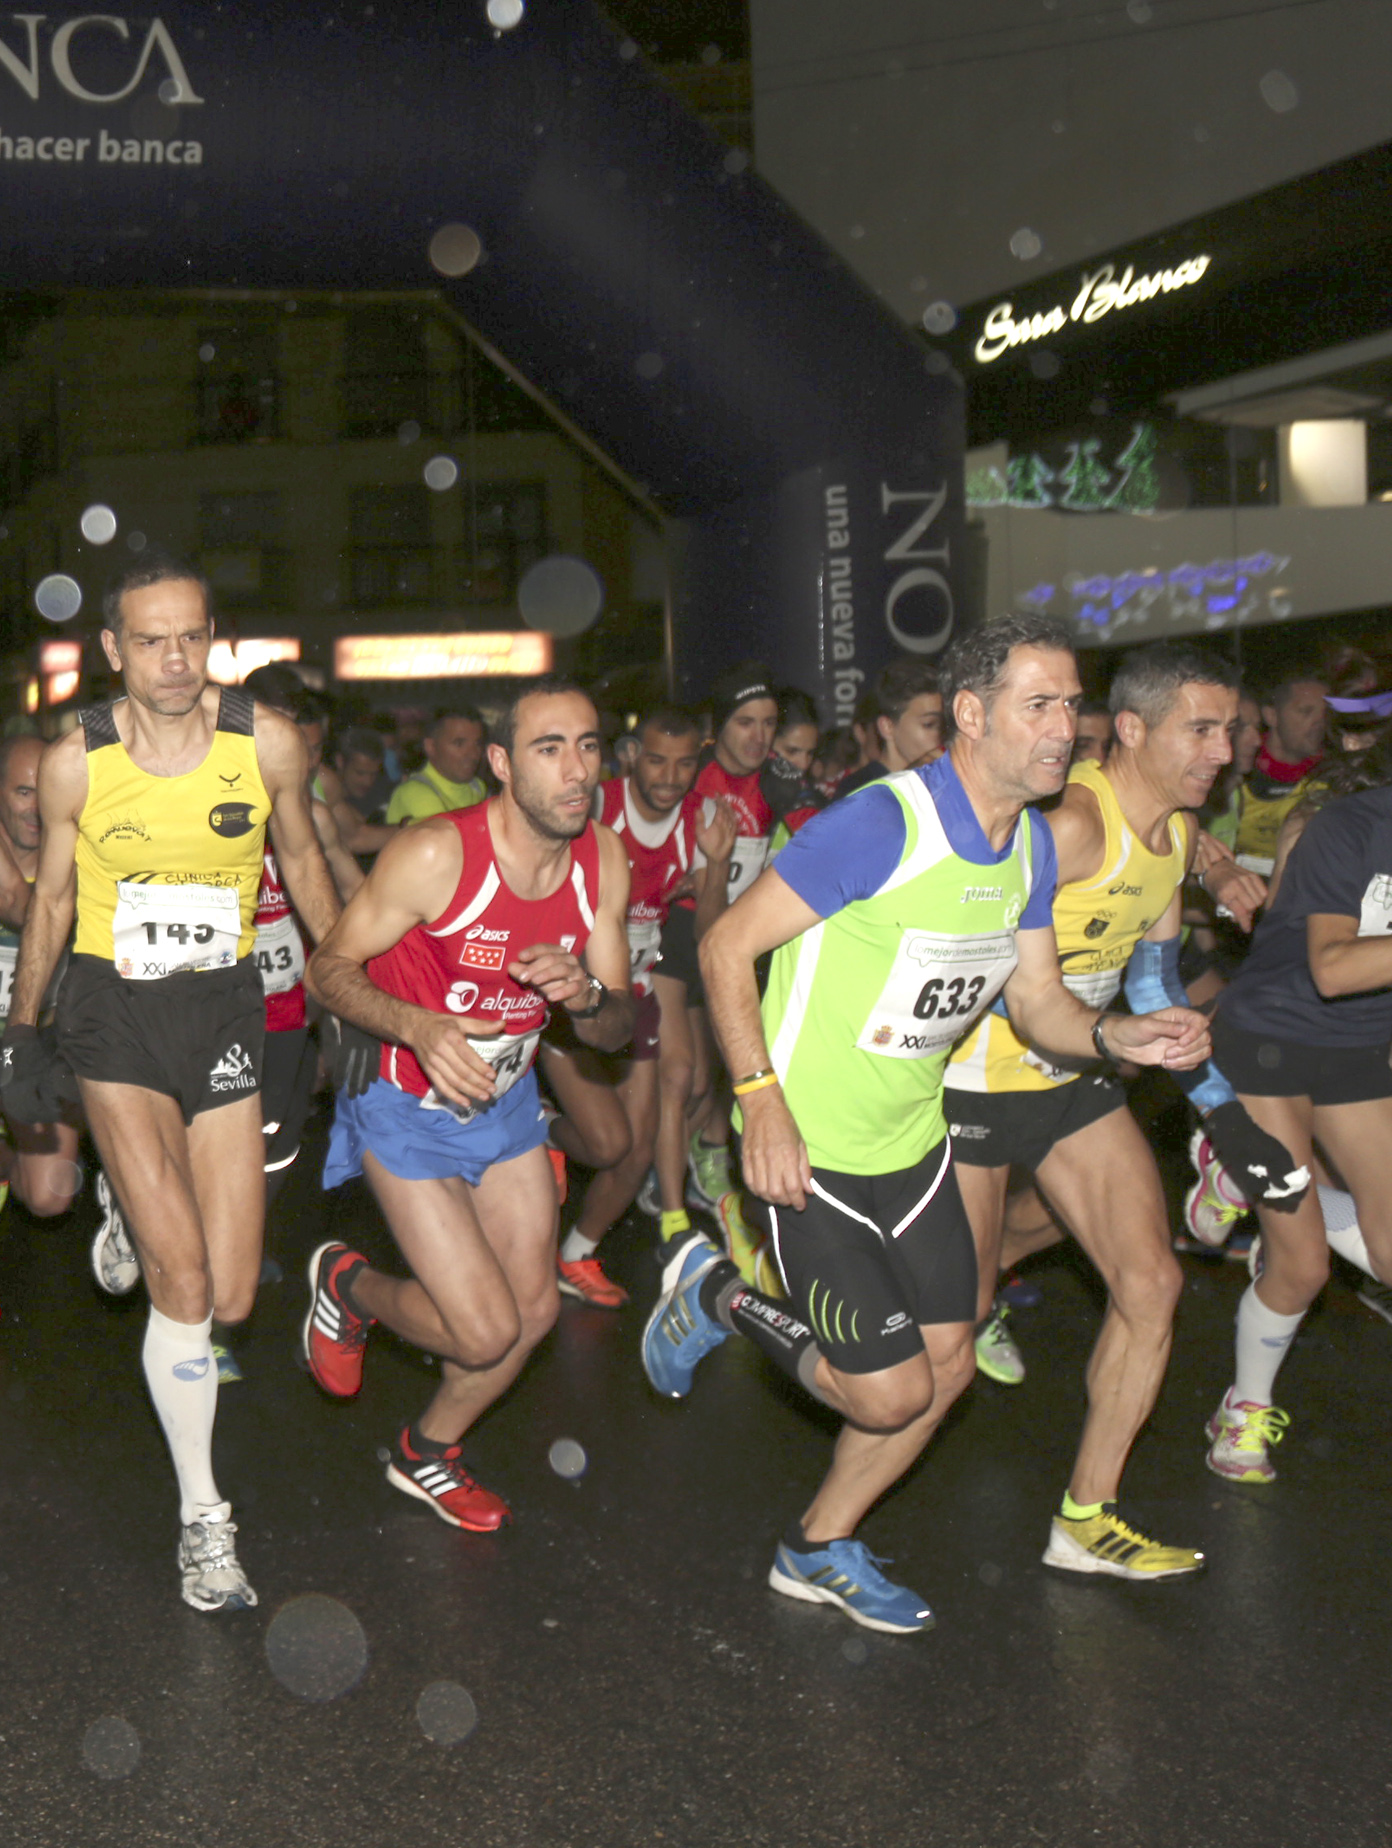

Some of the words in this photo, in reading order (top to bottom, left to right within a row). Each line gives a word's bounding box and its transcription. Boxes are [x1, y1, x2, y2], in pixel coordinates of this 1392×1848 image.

[98, 130, 204, 165] banca
[825, 485, 851, 549] una
[881, 480, 954, 654] NO
[829, 556, 856, 662] nueva
[912, 976, 987, 1020] 633
[898, 1034, 927, 1049] XXI
[210, 1074, 257, 1092] Sevilla
